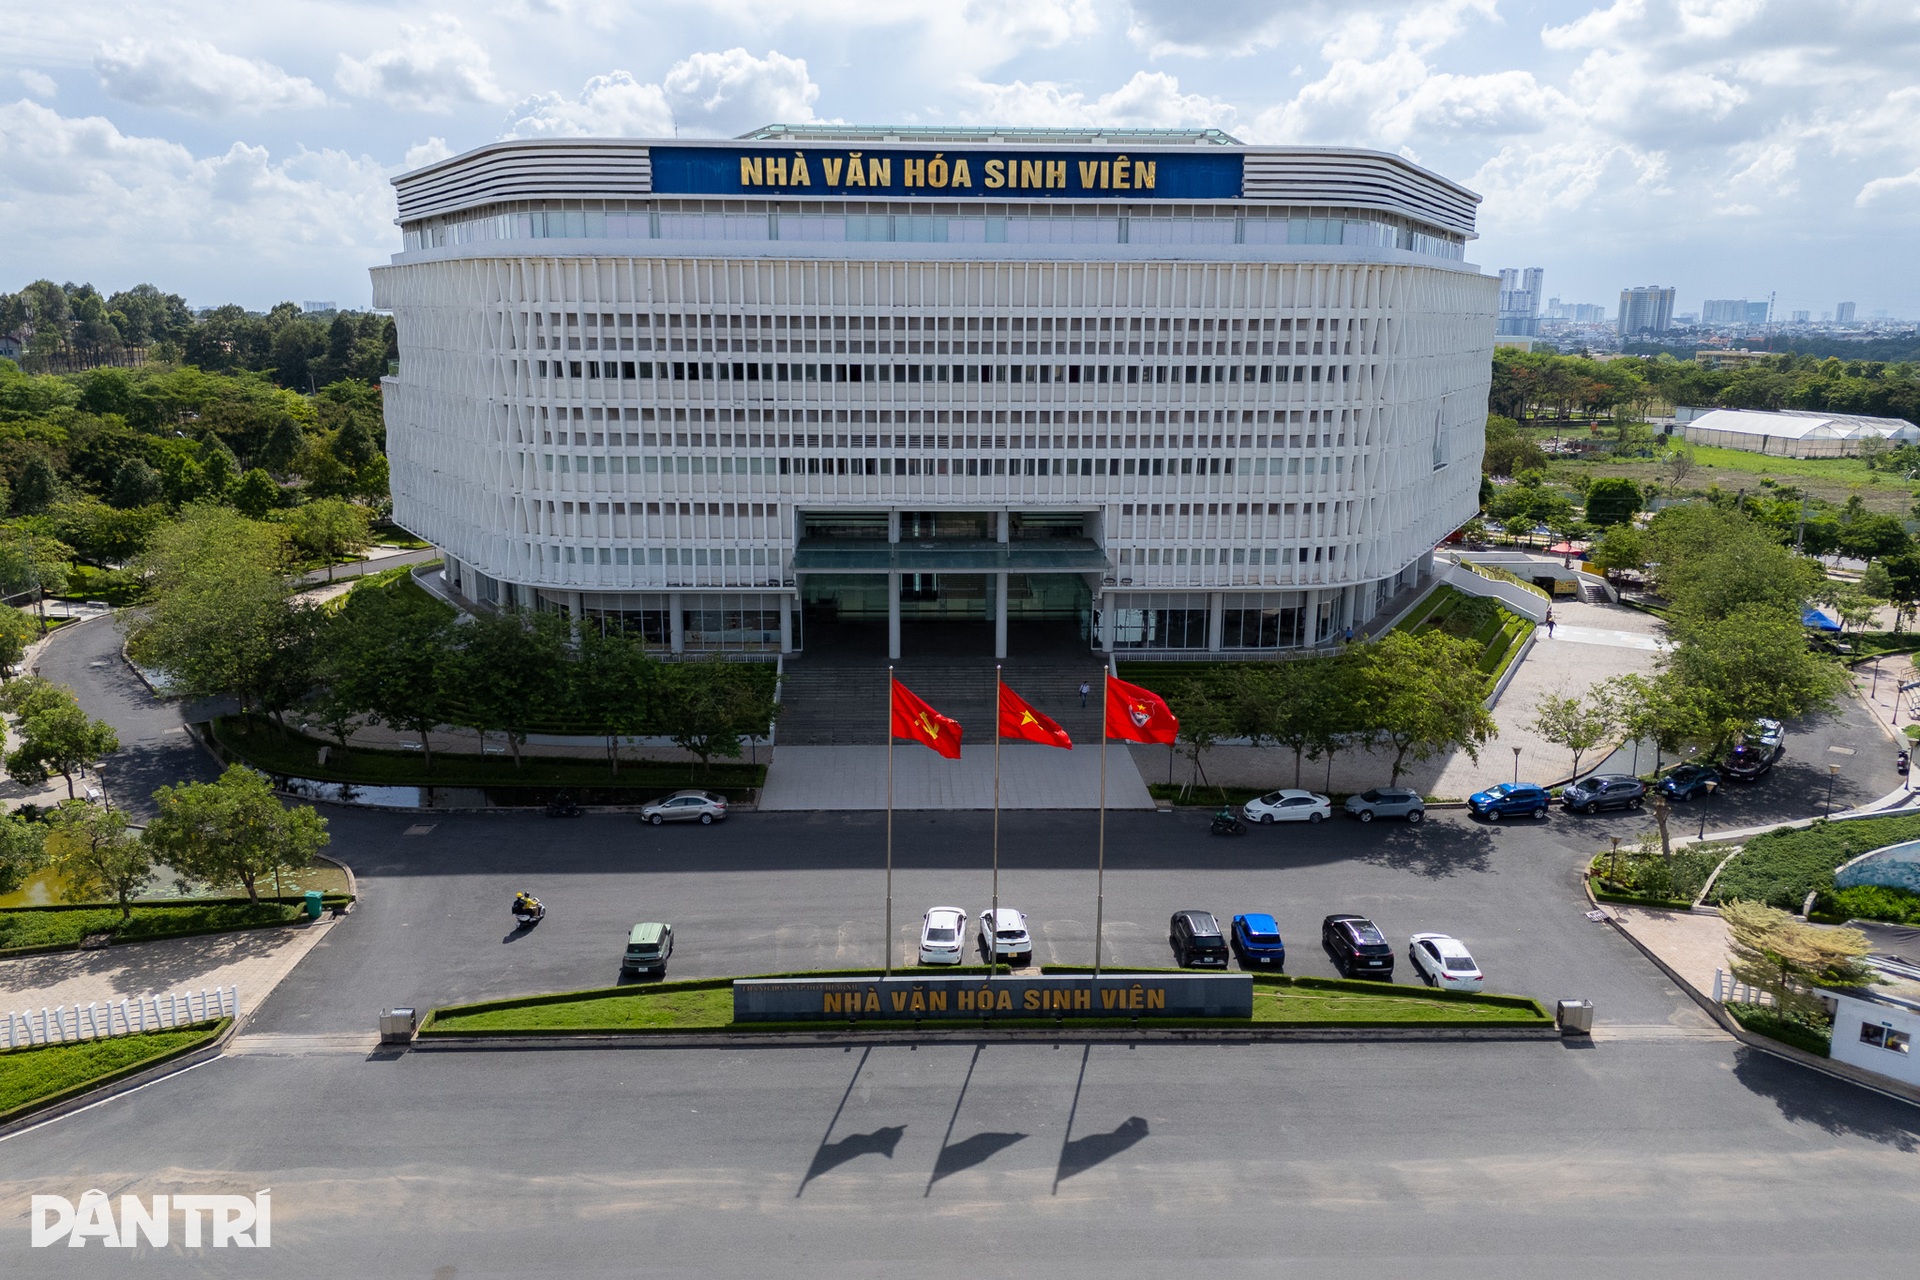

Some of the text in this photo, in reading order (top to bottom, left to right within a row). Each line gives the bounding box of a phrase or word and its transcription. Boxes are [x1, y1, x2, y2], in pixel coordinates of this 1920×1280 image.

[740, 151, 1156, 189] NHÀ VĂN HÓA SINH VIÊN
[823, 984, 1165, 1013] NHÀ VĂN HÓA SINH VIÊN
